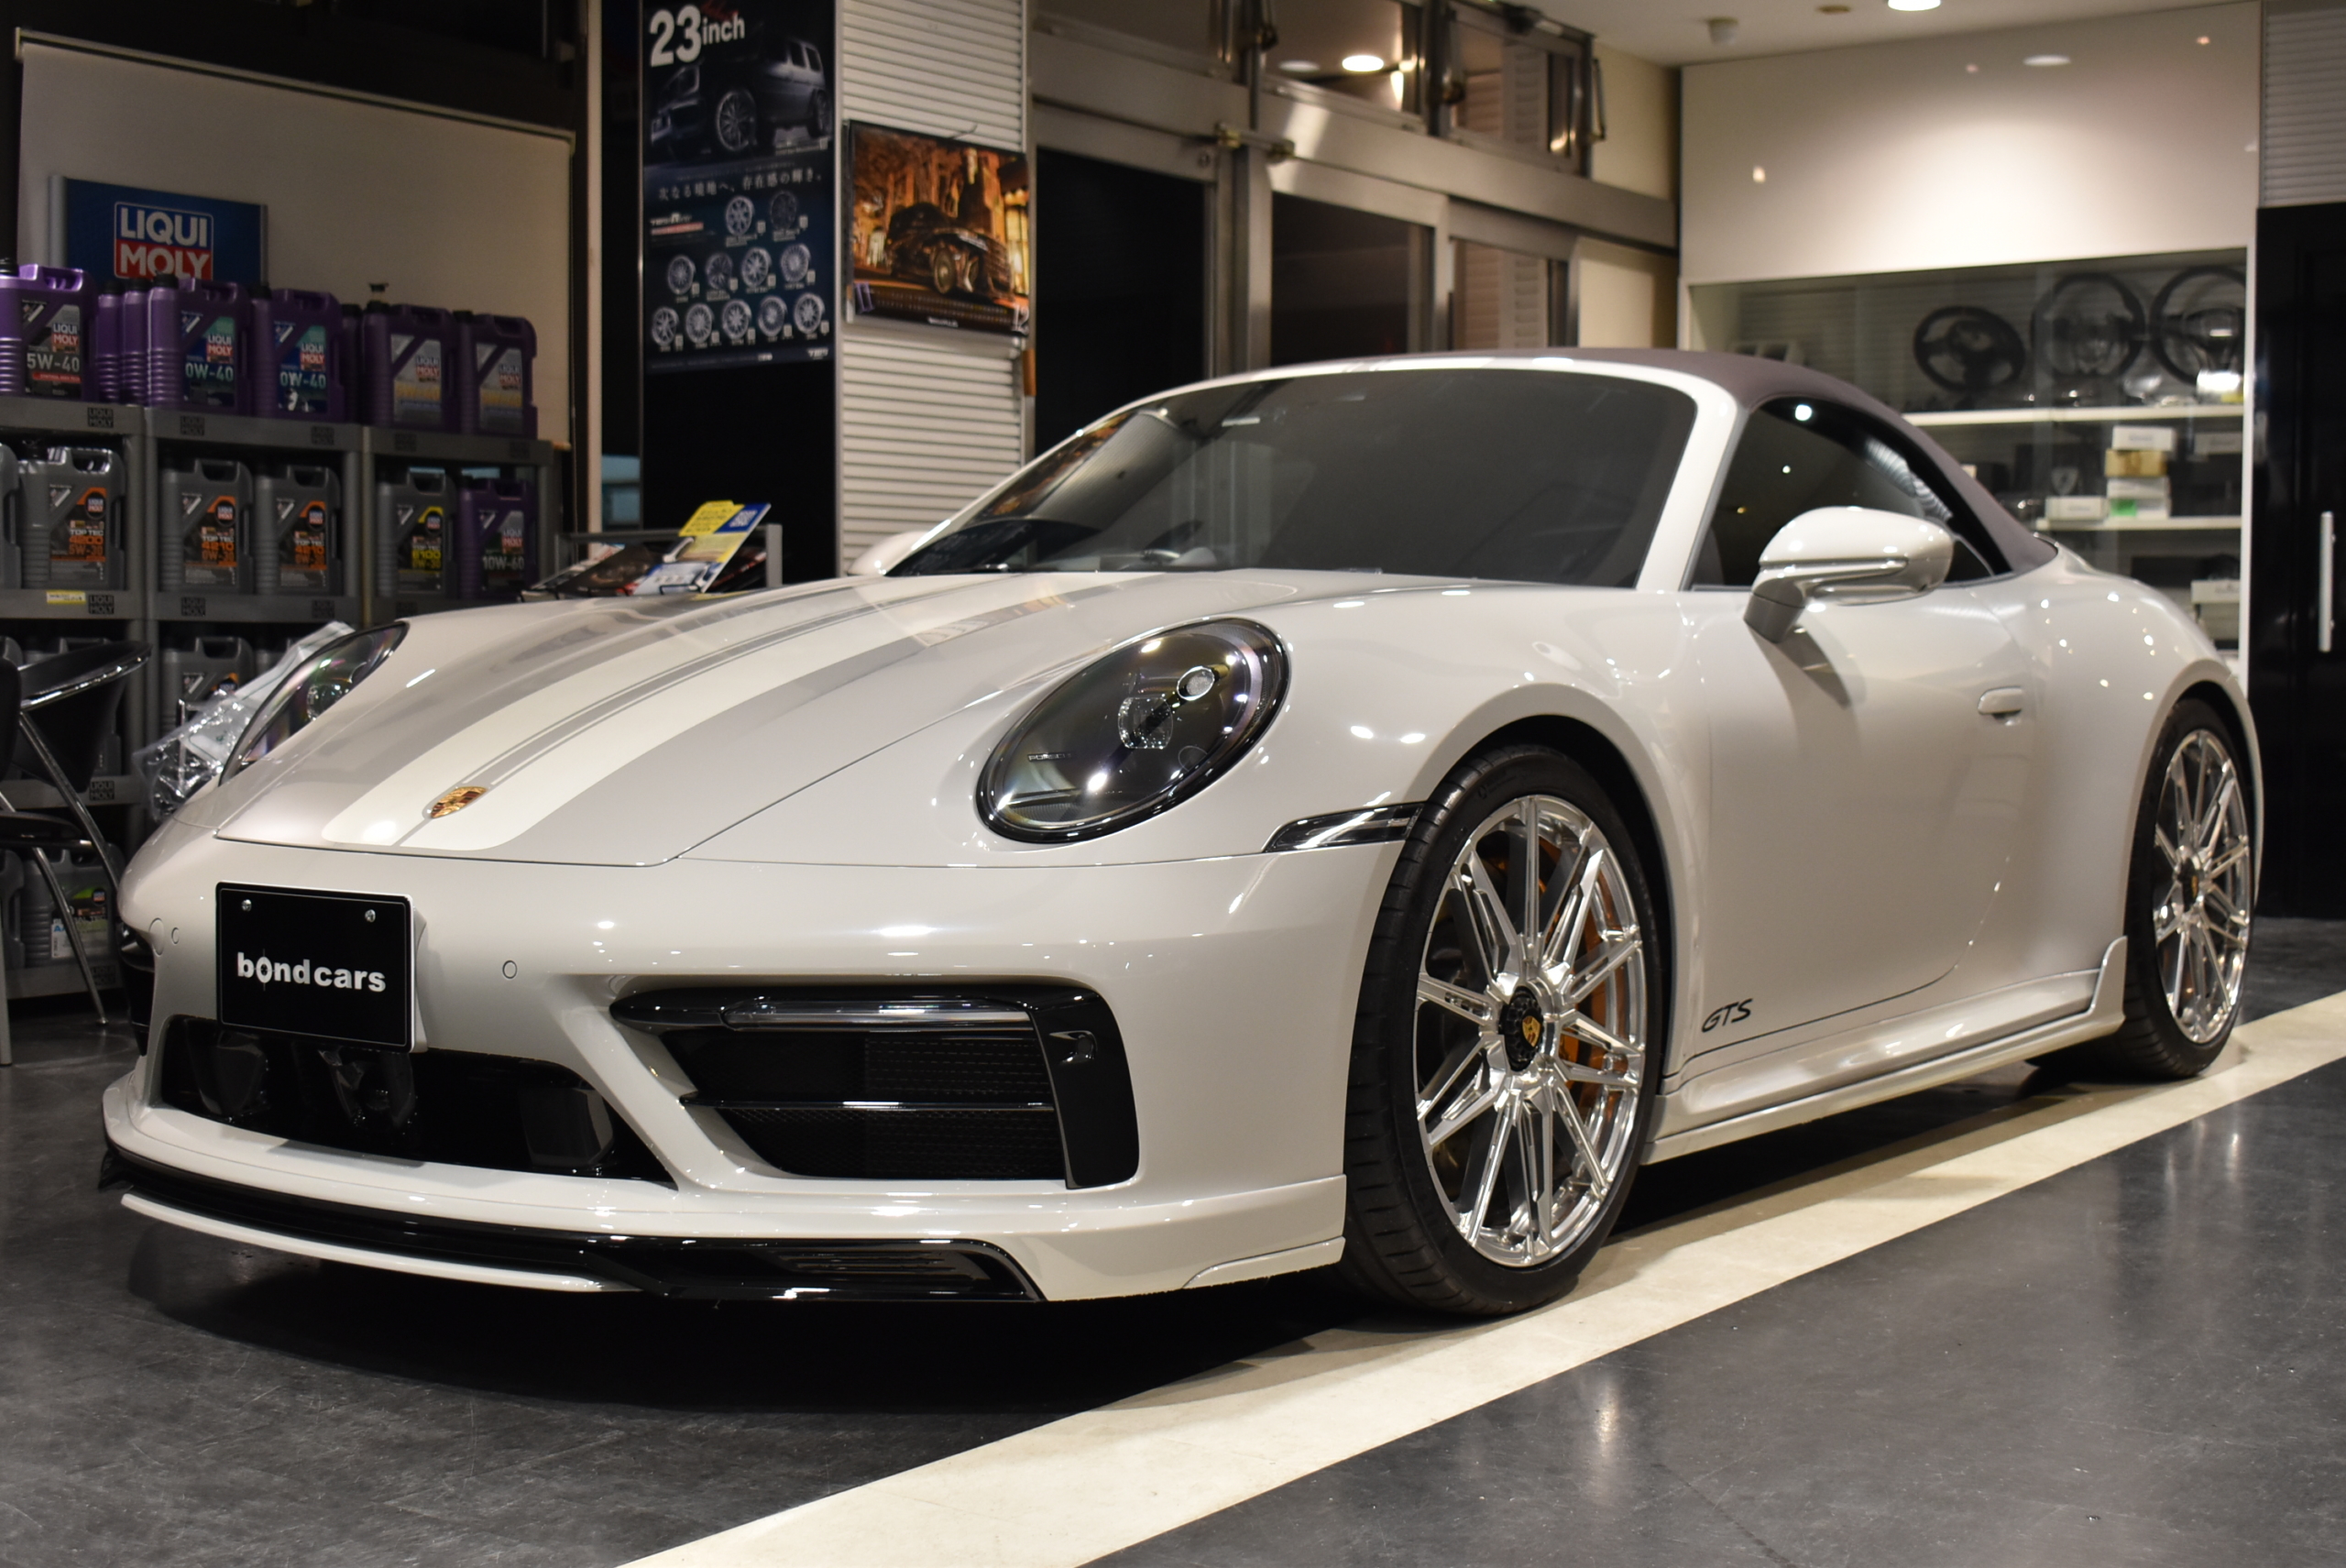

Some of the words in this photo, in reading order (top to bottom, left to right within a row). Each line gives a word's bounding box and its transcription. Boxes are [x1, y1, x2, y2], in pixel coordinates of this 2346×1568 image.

[650, 5, 702, 67] 23
[702, 12, 745, 45] inch
[120, 207, 208, 247] LIQUI
[120, 243, 211, 280] MOLY
[52, 323, 78, 334] LIQUI
[52, 334, 79, 345] MOLY
[207, 345, 234, 356] MOLY
[27, 353, 80, 372] 5W-40
[185, 363, 234, 382] 0W-40
[280, 371, 326, 390] 0W-40
[69, 544, 104, 555] 5W-30
[482, 555, 524, 570] 10W-60
[1702, 997, 1754, 1033] GTS
